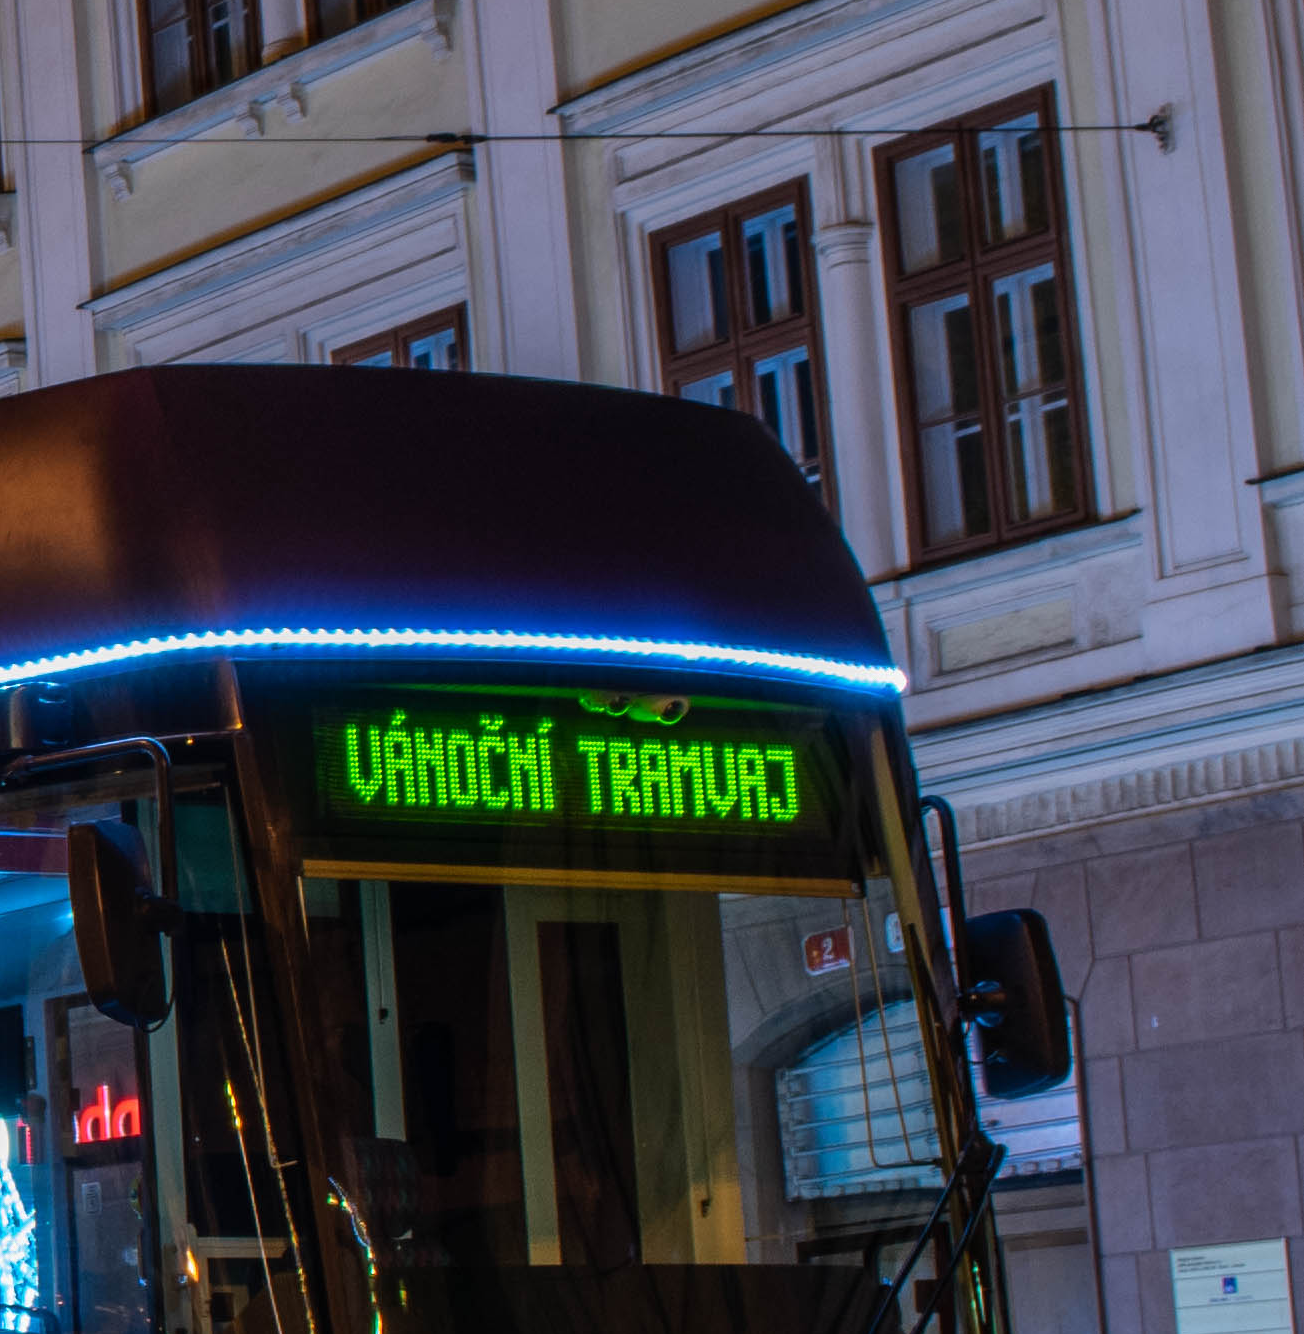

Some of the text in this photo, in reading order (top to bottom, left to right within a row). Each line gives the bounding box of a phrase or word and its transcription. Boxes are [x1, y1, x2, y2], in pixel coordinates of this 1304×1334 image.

[345, 709, 799, 822] VÁNOČNÍ TRAMVAJ
[822, 937, 834, 961] 2
[74, 1085, 141, 1143] da
